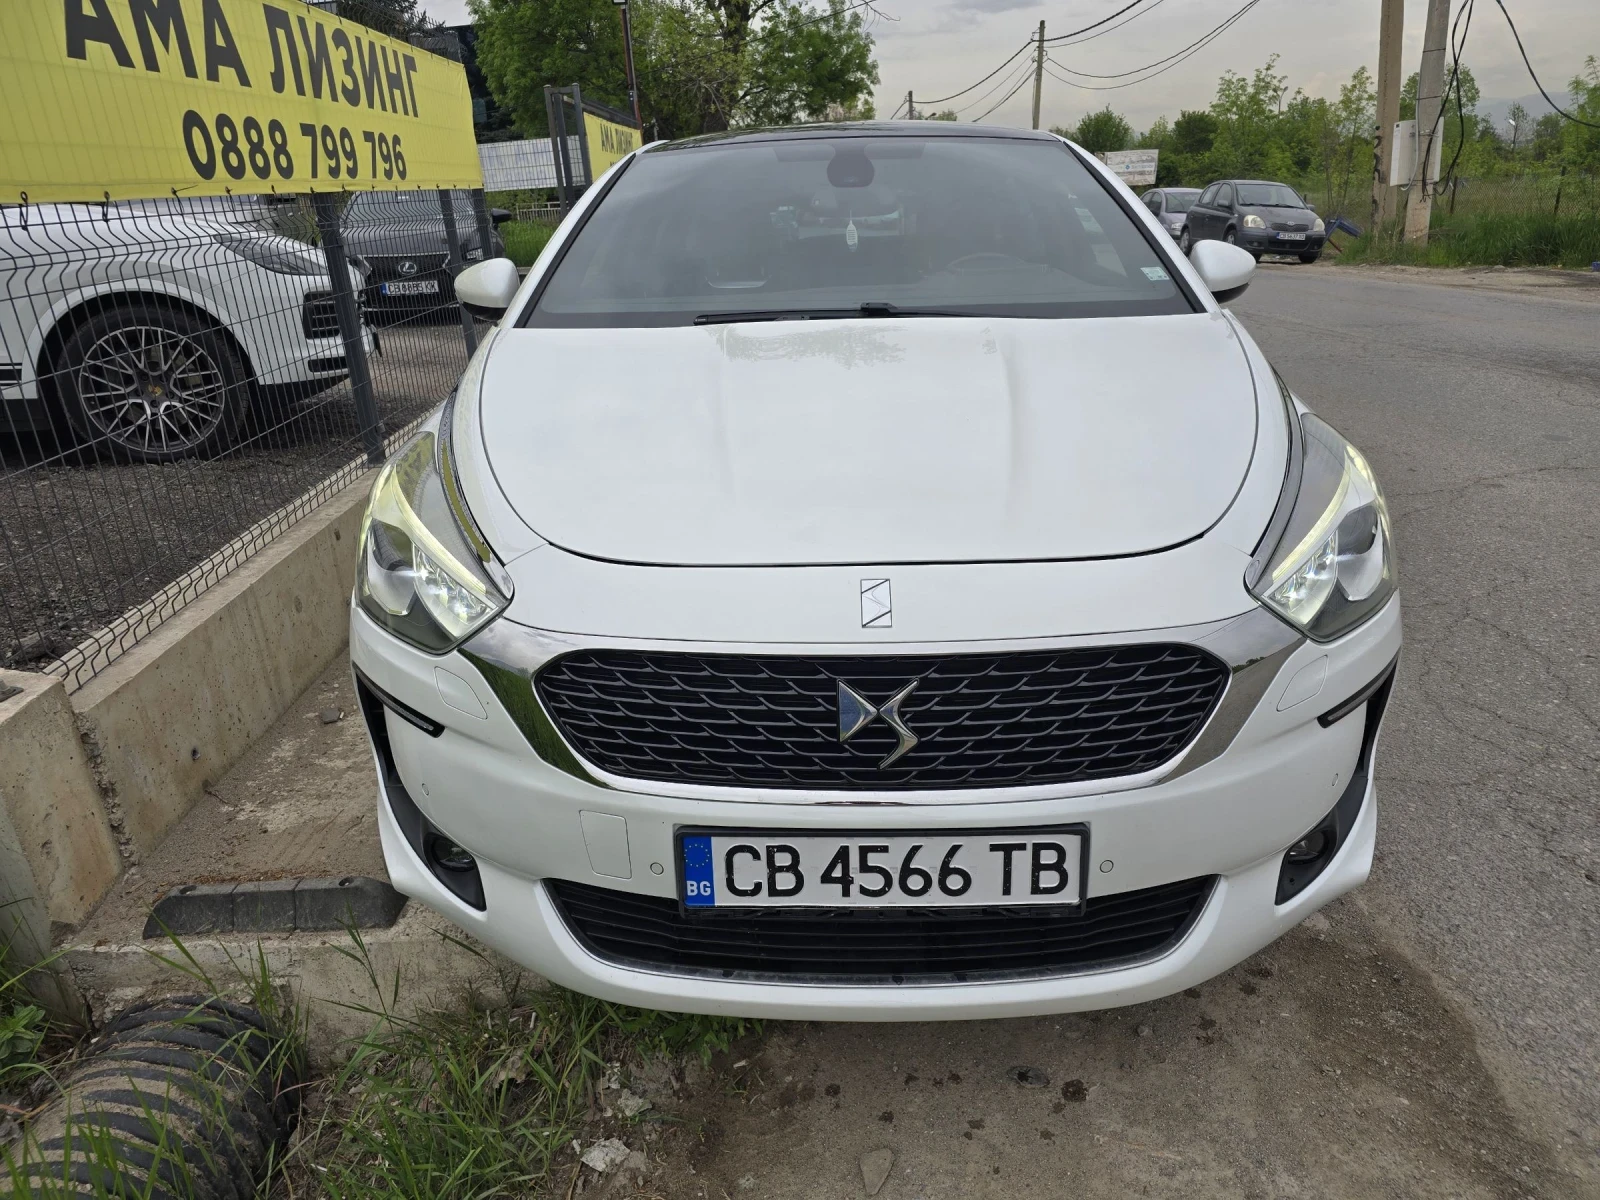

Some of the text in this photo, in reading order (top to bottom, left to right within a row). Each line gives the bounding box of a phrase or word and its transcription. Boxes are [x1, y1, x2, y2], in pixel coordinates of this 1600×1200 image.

[262, 3, 418, 118] ЛИЗИНГ
[182, 109, 407, 181] 0888 799 796
[686, 881, 711, 896] BG
[725, 842, 1069, 898] CB 4566 TB
